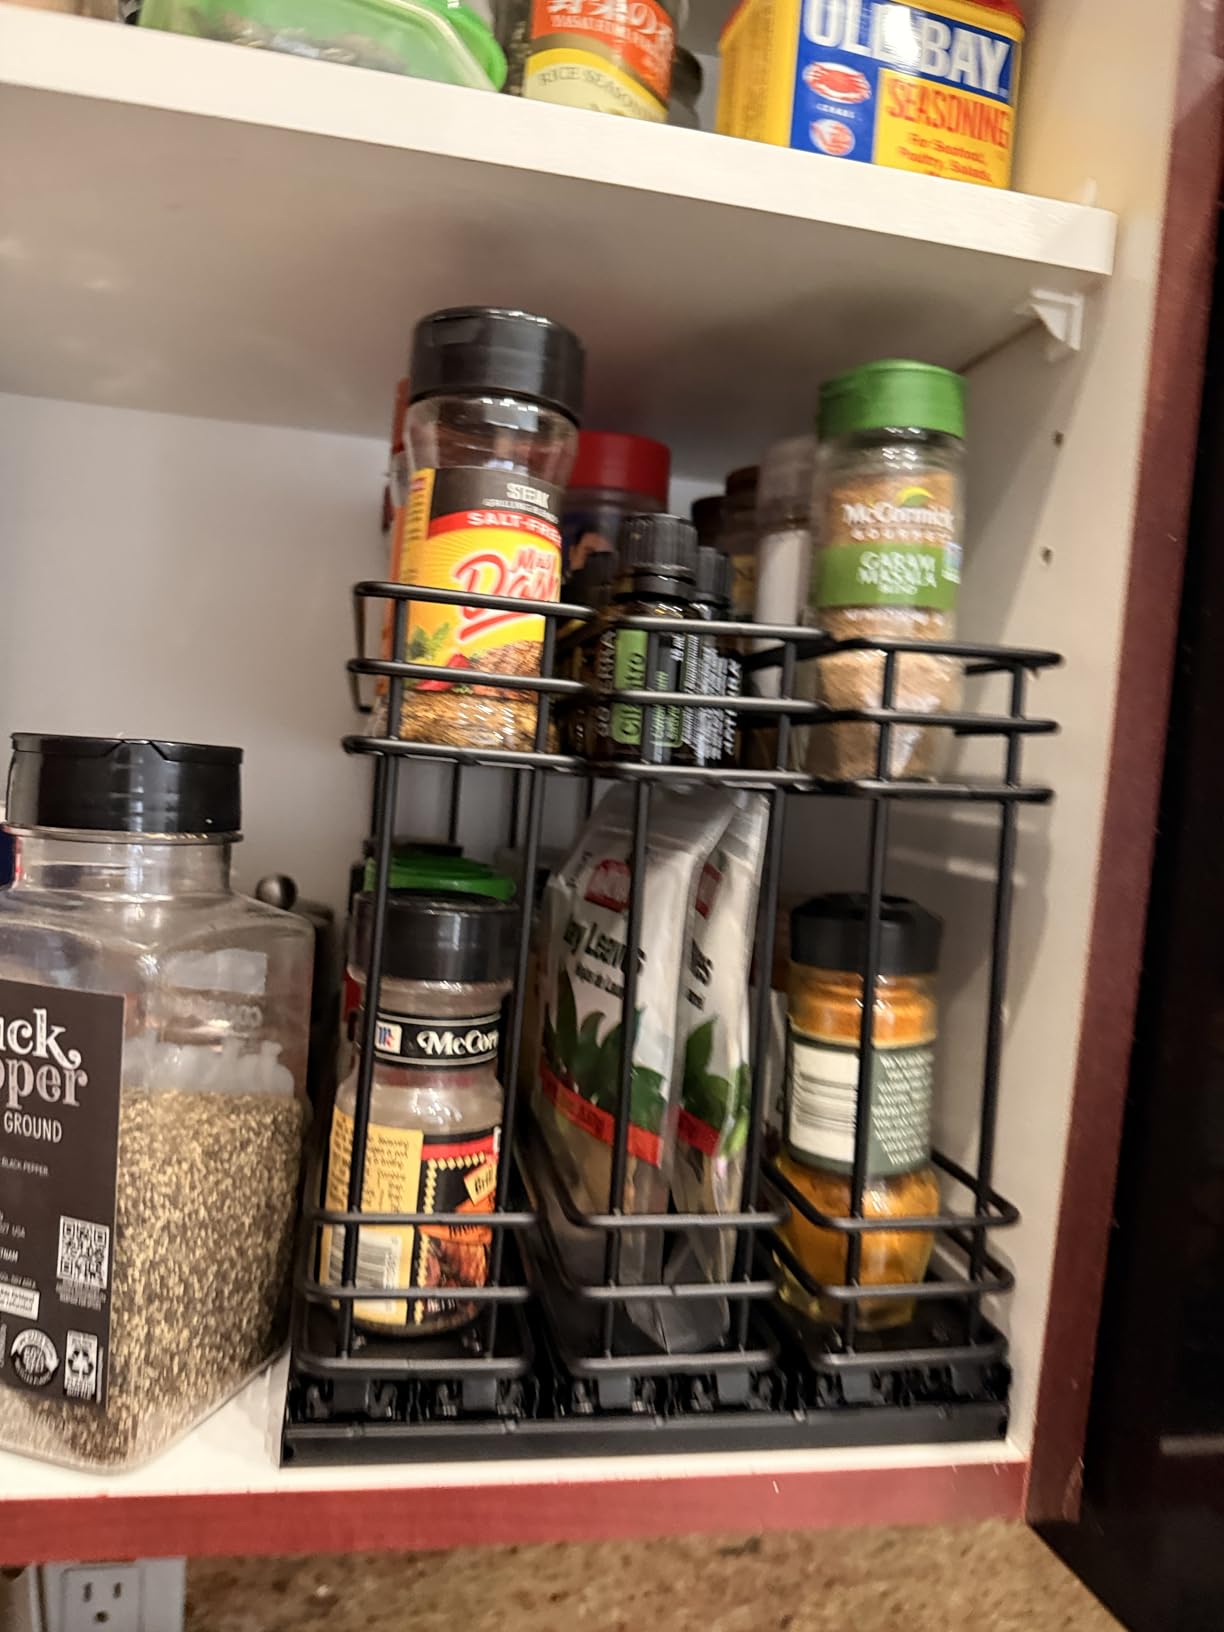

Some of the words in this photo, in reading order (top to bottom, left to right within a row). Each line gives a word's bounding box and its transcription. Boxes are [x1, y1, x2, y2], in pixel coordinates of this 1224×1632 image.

[914, 15, 1011, 96] BAY
[887, 79, 1009, 149] SEASONING
[841, 501, 954, 533] McCormick
[0, 1008, 82, 1070] ck
[0, 1058, 88, 1110] per
[4, 1110, 63, 1143] GROUND
